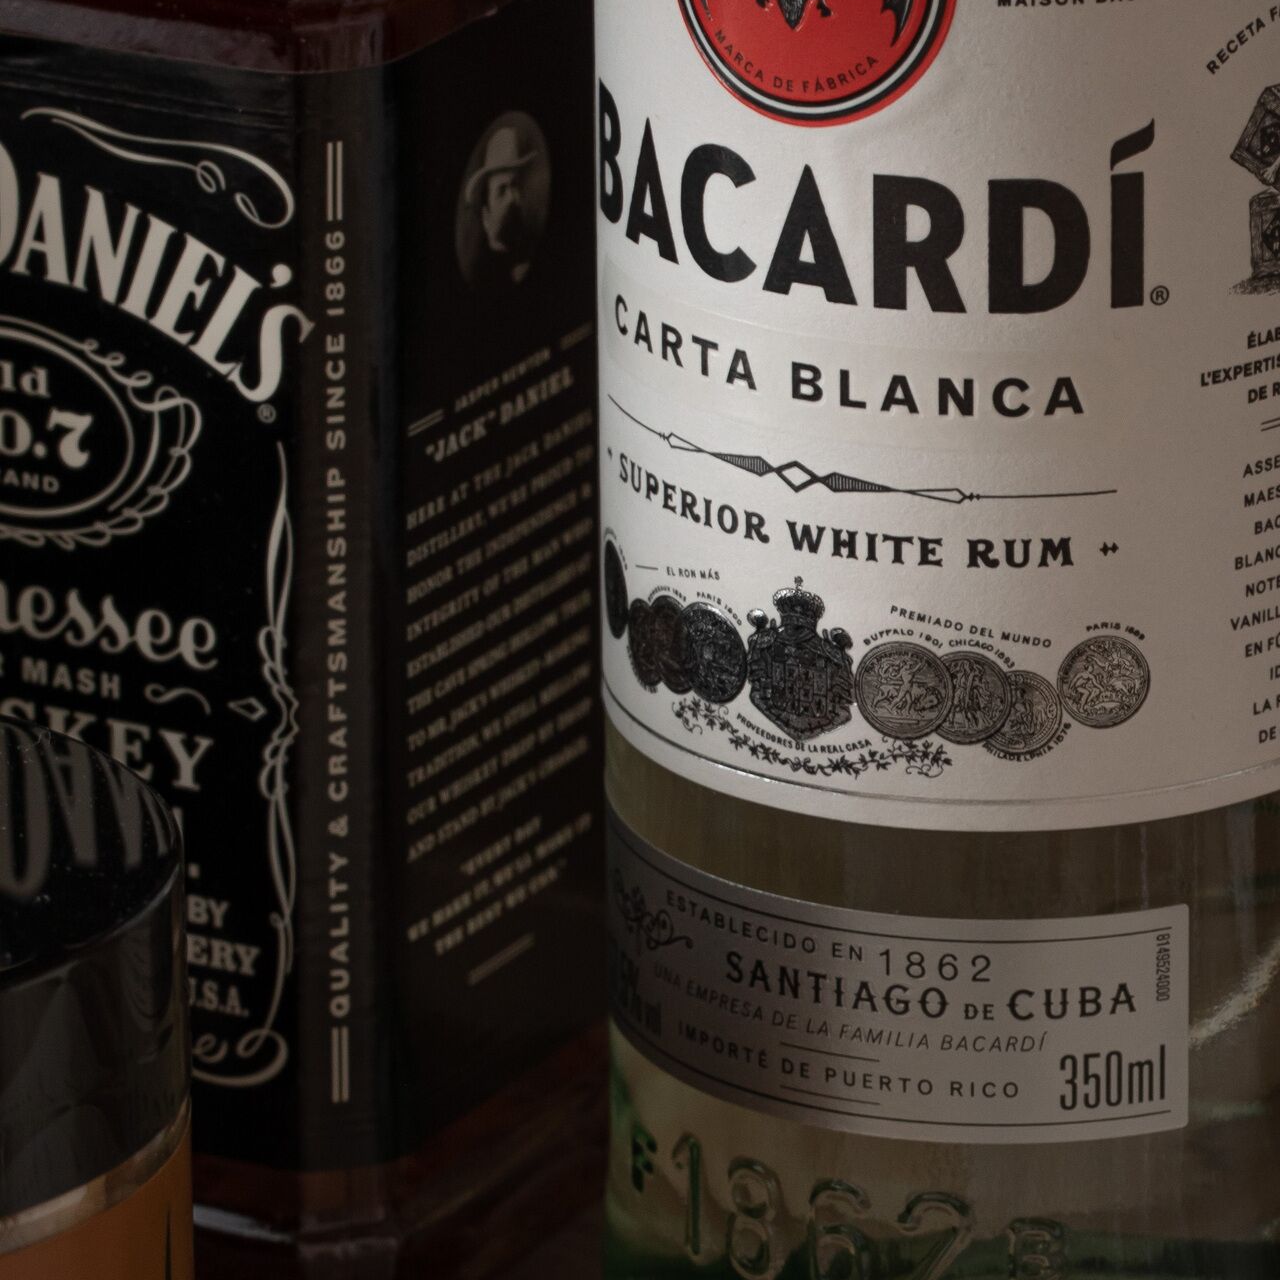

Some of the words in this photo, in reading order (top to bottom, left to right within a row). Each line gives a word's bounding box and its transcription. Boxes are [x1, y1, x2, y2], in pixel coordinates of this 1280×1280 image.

[714, 29, 764, 83] MARCA
[772, 76, 794, 92] DE
[802, 55, 879, 94] FÁBRICA
[1206, 17, 1266, 75] RECETA
[599, 78, 1155, 314] BACARDÍ
[0, 135, 316, 404] ANIEL'S
[325, 230, 346, 316] 1866
[325, 332, 347, 450] SINCE
[615, 294, 757, 391] CARTA
[791, 361, 1085, 418] BLANCA
[499, 365, 573, 425] DANIEL
[1247, 386, 1267, 404] DE
[619, 453, 770, 544] SUPERIOR
[786, 519, 945, 568] WHITE
[966, 536, 1075, 569] RUM
[325, 466, 350, 802] CRAFTSMANSHIP
[890, 605, 964, 631] PREMIADO
[969, 624, 995, 639] DEL
[1000, 631, 1052, 648] MUNDO
[949, 638, 995, 653] CHICAGO
[1245, 640, 1263, 658] EN
[21, 656, 122, 700] MASH
[1252, 698, 1272, 716] LA
[736, 712, 793, 750] PROVEEDORES
[1259, 726, 1277, 744] DE
[328, 852, 351, 1017] QUALITY
[666, 889, 816, 954] ESTABLECIDO
[832, 942, 863, 962] EN
[879, 949, 991, 982] 1862
[686, 980, 763, 1021] EMPRESA
[771, 1009, 797, 1030] DE
[806, 1015, 829, 1037] LA
[840, 1024, 931, 1050] FAMILIA
[940, 1030, 1048, 1055] BACARDÍ
[726, 950, 950, 1019] SANTIAGO
[963, 1003, 995, 1021] DE
[1007, 982, 1138, 1022] CUBA
[678, 1021, 769, 1069] IMPORTÉ
[781, 1057, 811, 1080] DE
[825, 1067, 934, 1096] PUERTO
[950, 1081, 1019, 1099] RICO
[1058, 1045, 1166, 1112] 350ml
